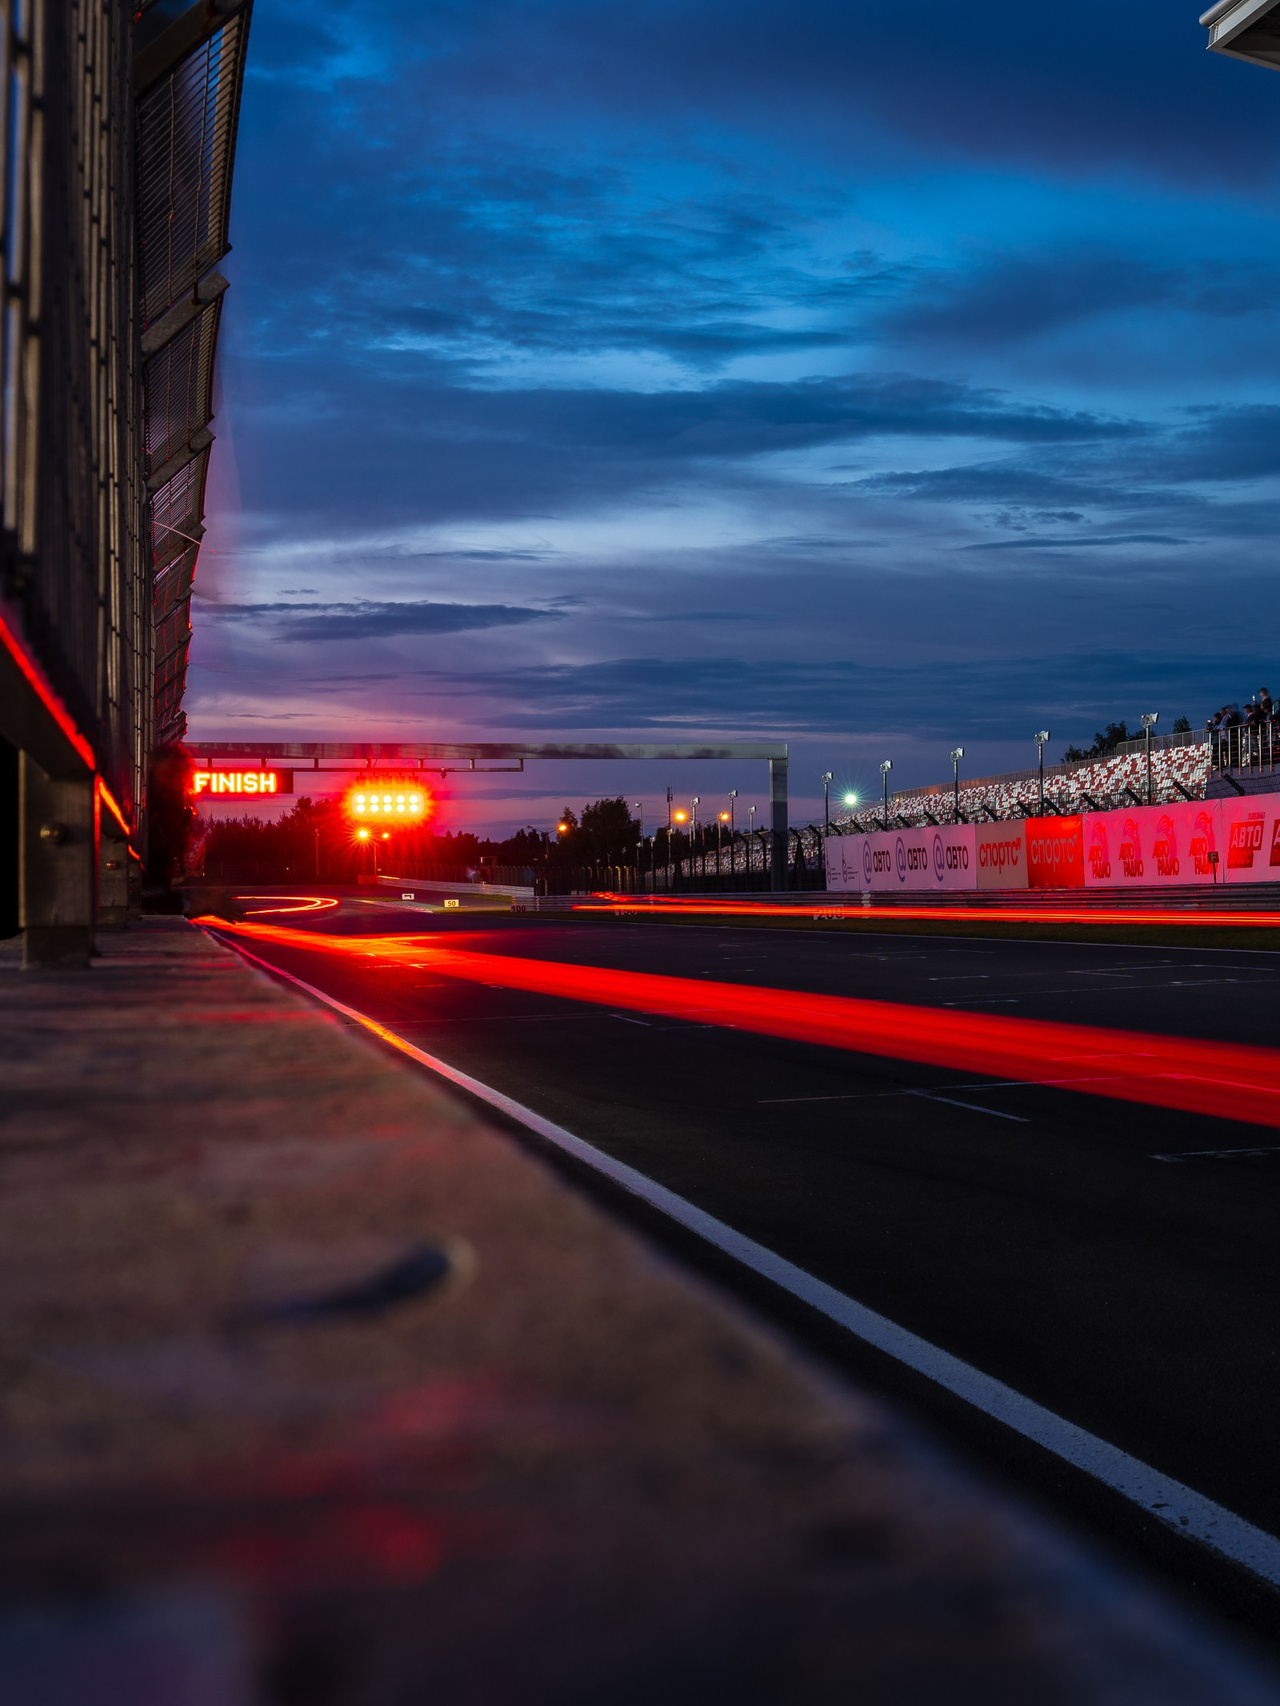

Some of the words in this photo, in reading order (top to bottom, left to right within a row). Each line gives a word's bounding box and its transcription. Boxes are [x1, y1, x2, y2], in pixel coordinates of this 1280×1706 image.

[193, 771, 277, 794] FINISH
[1230, 825, 1262, 848] АВТО
[1210, 852, 1217, 862] F
[510, 904, 527, 913] 100
